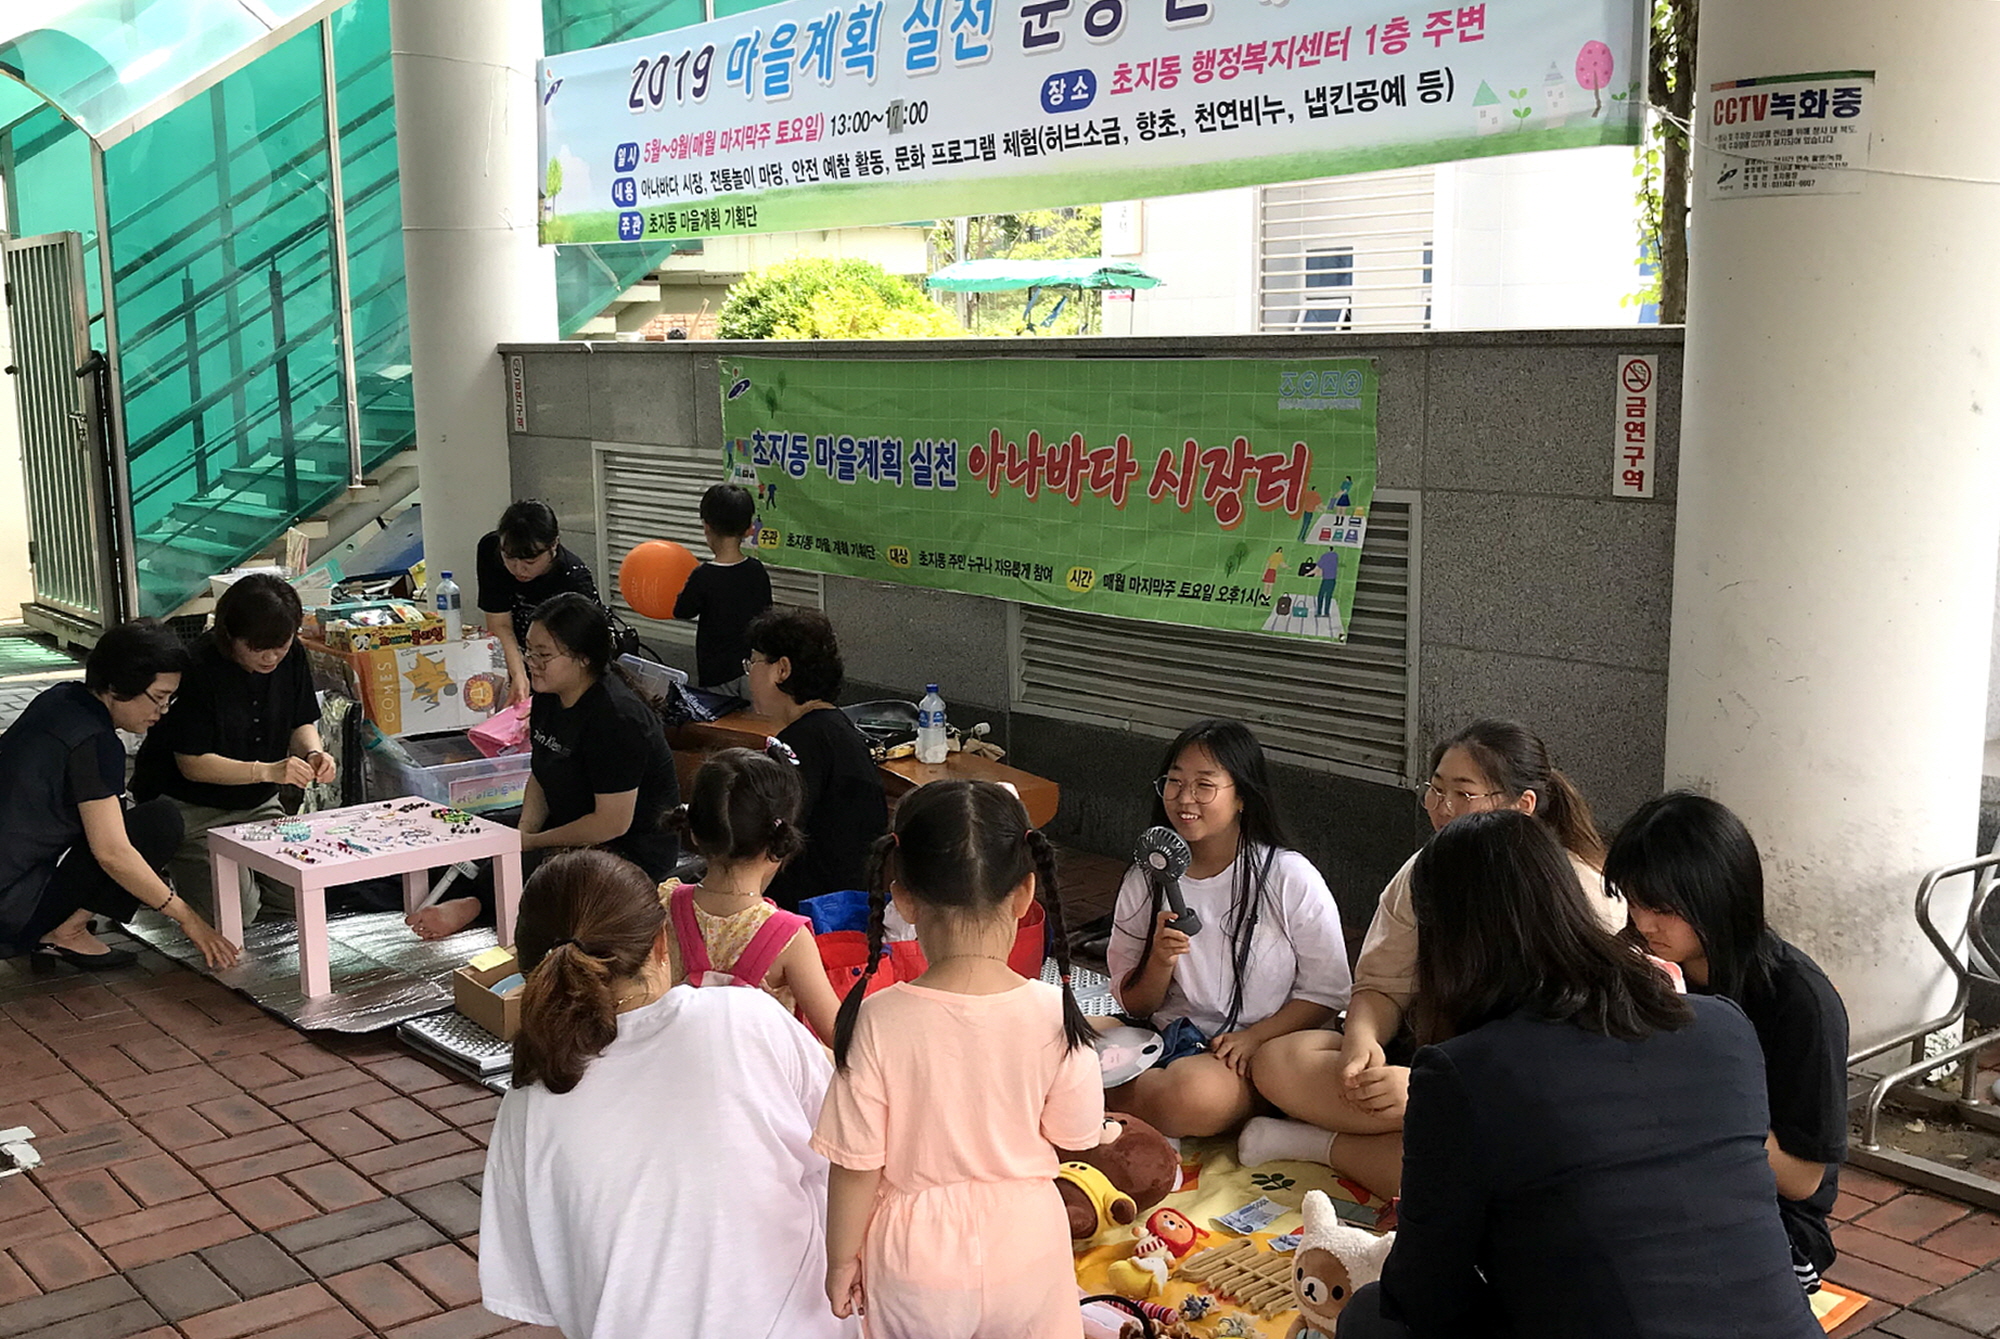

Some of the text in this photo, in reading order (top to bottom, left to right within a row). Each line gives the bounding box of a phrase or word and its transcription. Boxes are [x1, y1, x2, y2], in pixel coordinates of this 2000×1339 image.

[628, 44, 716, 109] 2019
[725, 1, 883, 97] 마을계획
[1110, 54, 1181, 95] 초지동
[1191, 25, 1352, 84] 행정복지센터
[1365, 16, 1411, 55] 1층
[1422, 3, 1486, 48] 주변
[641, 177, 679, 199] 아나바다
[683, 171, 708, 195] 시장,
[710, 166, 757, 192] 전통놀이
[759, 162, 789, 185] 마당,
[792, 157, 819, 183] 안전
[822, 153, 850, 180] 예찰
[855, 149, 890, 177] 활동,
[894, 144, 926, 172] 문화
[931, 133, 996, 166] 프로그램
[1002, 117, 1129, 158] 체험(허브소금,
[1136, 108, 1186, 142] 향초,
[1195, 94, 1294, 133] 천연비누,
[1305, 74, 1407, 119] 냅킨공예
[1416, 67, 1455, 104] 등)
[643, 130, 716, 163] 5월~9월(매월
[720, 122, 771, 153] 마지막주
[775, 111, 825, 144] 토요일)
[648, 212, 677, 234] 초지동
[680, 207, 721, 232] 마을계획
[725, 205, 758, 229] 기획단
[752, 428, 1310, 525] 초지동 마을계획 실천 아나바다 시장터
[1622, 396, 1647, 492] 금연구역
[761, 529, 779, 545] 주관
[786, 532, 813, 550] 초지동
[889, 548, 908, 565] 대상
[919, 551, 946, 570] 초지동
[949, 554, 967, 571] 주민
[967, 557, 992, 575] 누구나
[1033, 564, 1053, 583] 참여
[1069, 569, 1093, 589] 시간
[1102, 572, 1125, 593] 매월
[1129, 575, 1176, 598] 마지막주
[1177, 581, 1215, 602] 토요일
[1215, 585, 1271, 607] 오후1시~
[377, 660, 396, 723] COMES
